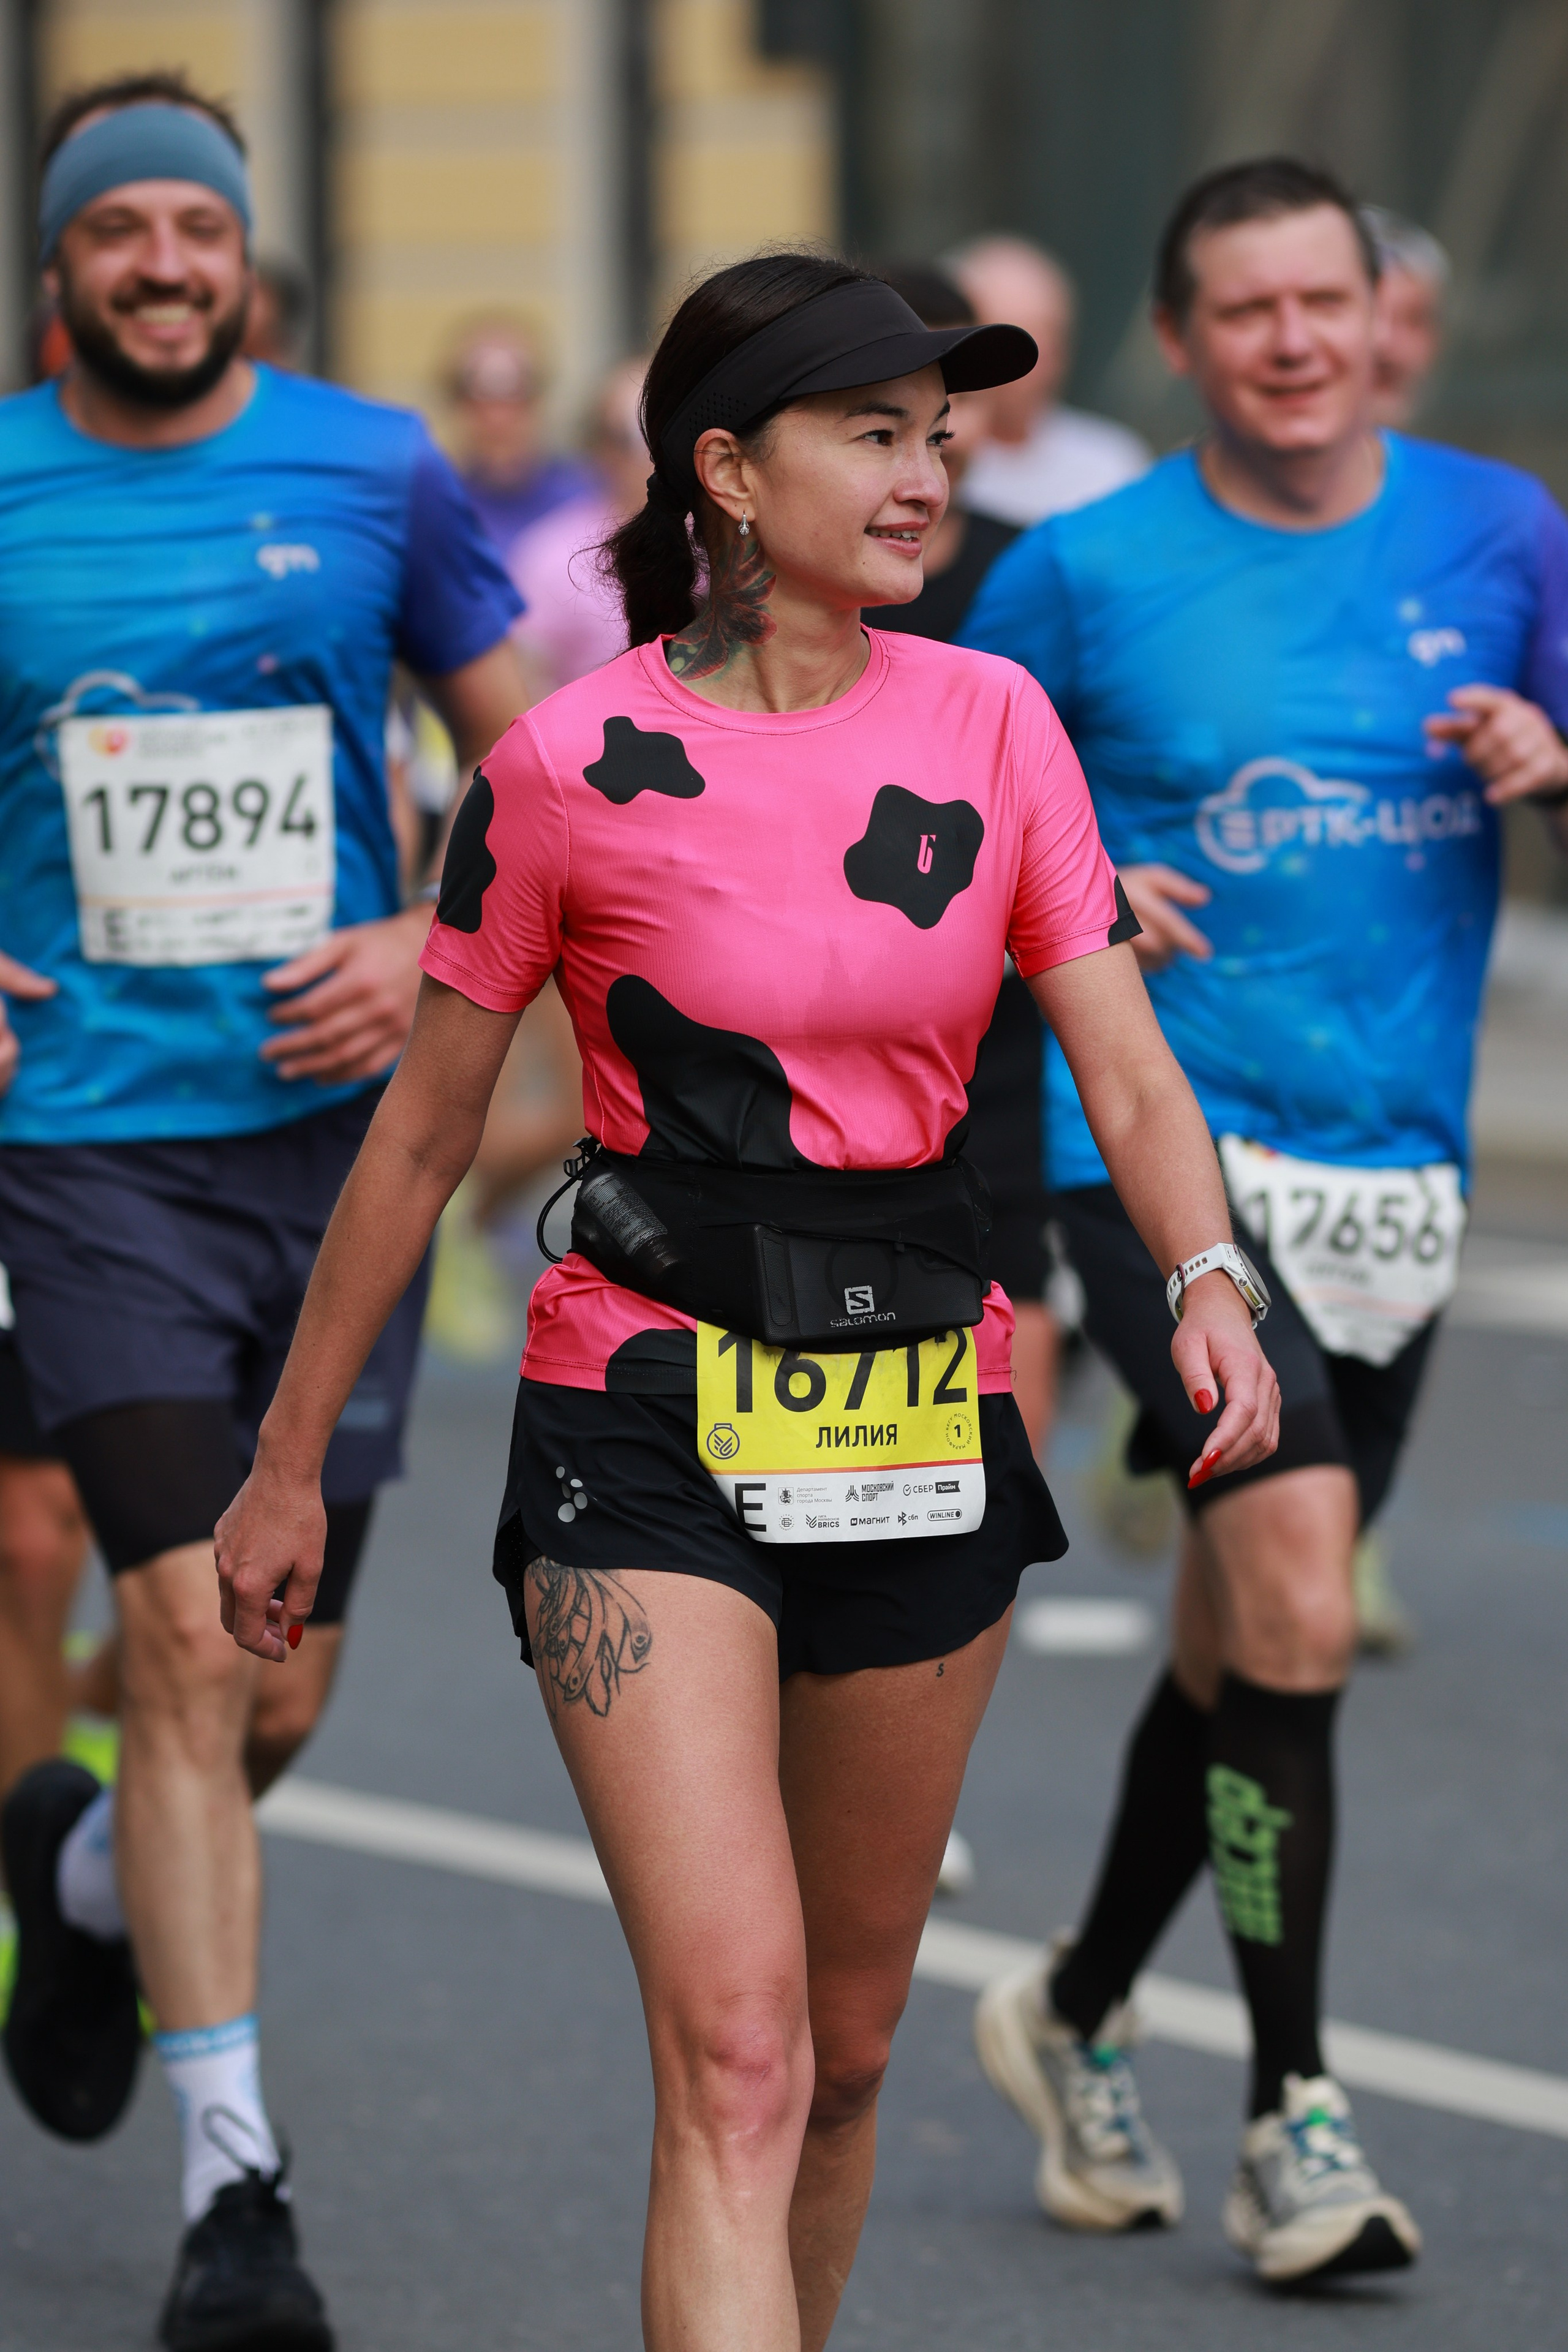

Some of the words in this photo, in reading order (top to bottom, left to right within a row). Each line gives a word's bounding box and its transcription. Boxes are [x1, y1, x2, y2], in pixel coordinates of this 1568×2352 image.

[82, 774, 316, 854] 17894
[1246, 1186, 1446, 1264] 17656
[816, 1423, 897, 1449] ЛИЛИЯ
[954, 1424, 961, 1438] 1
[861, 1480, 894, 1493] МОСКОВСКИЙ
[913, 1485, 934, 1493] СБЕР
[938, 1483, 956, 1491] Прайм
[734, 1483, 767, 1532] E
[861, 1493, 879, 1502] СПОРТ
